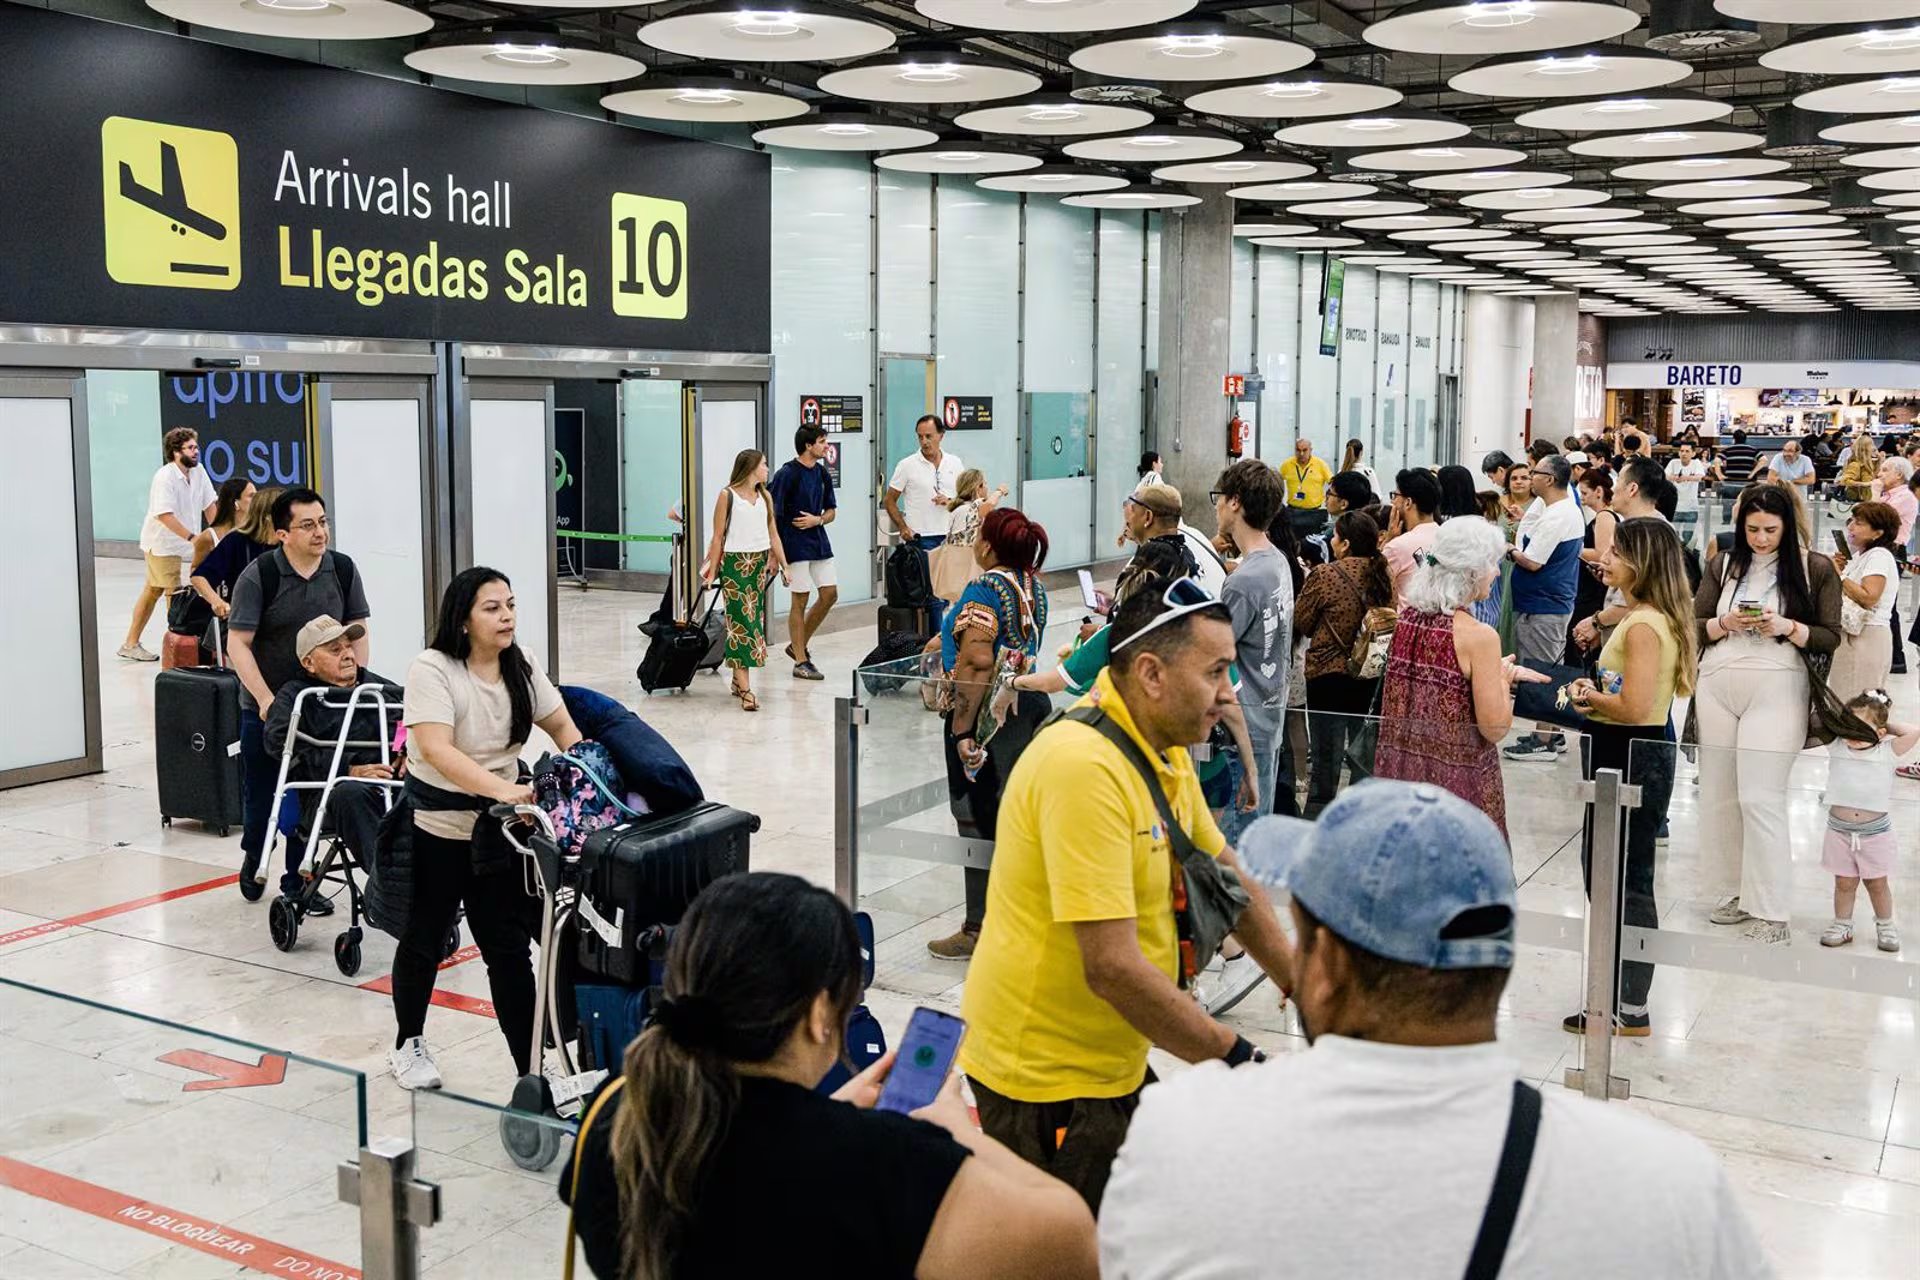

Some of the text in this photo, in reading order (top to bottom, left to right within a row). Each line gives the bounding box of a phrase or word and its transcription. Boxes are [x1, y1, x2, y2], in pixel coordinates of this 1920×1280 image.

[274, 150, 511, 228] Arrivals hall
[278, 224, 588, 307] Llegadas Sala
[617, 216, 682, 298] 10
[1667, 365, 1742, 386] BARETO
[199, 440, 306, 484] o su
[118, 1205, 154, 1220] NO
[147, 1214, 256, 1255] BLOQUEAR
[272, 1256, 312, 1273] DO
